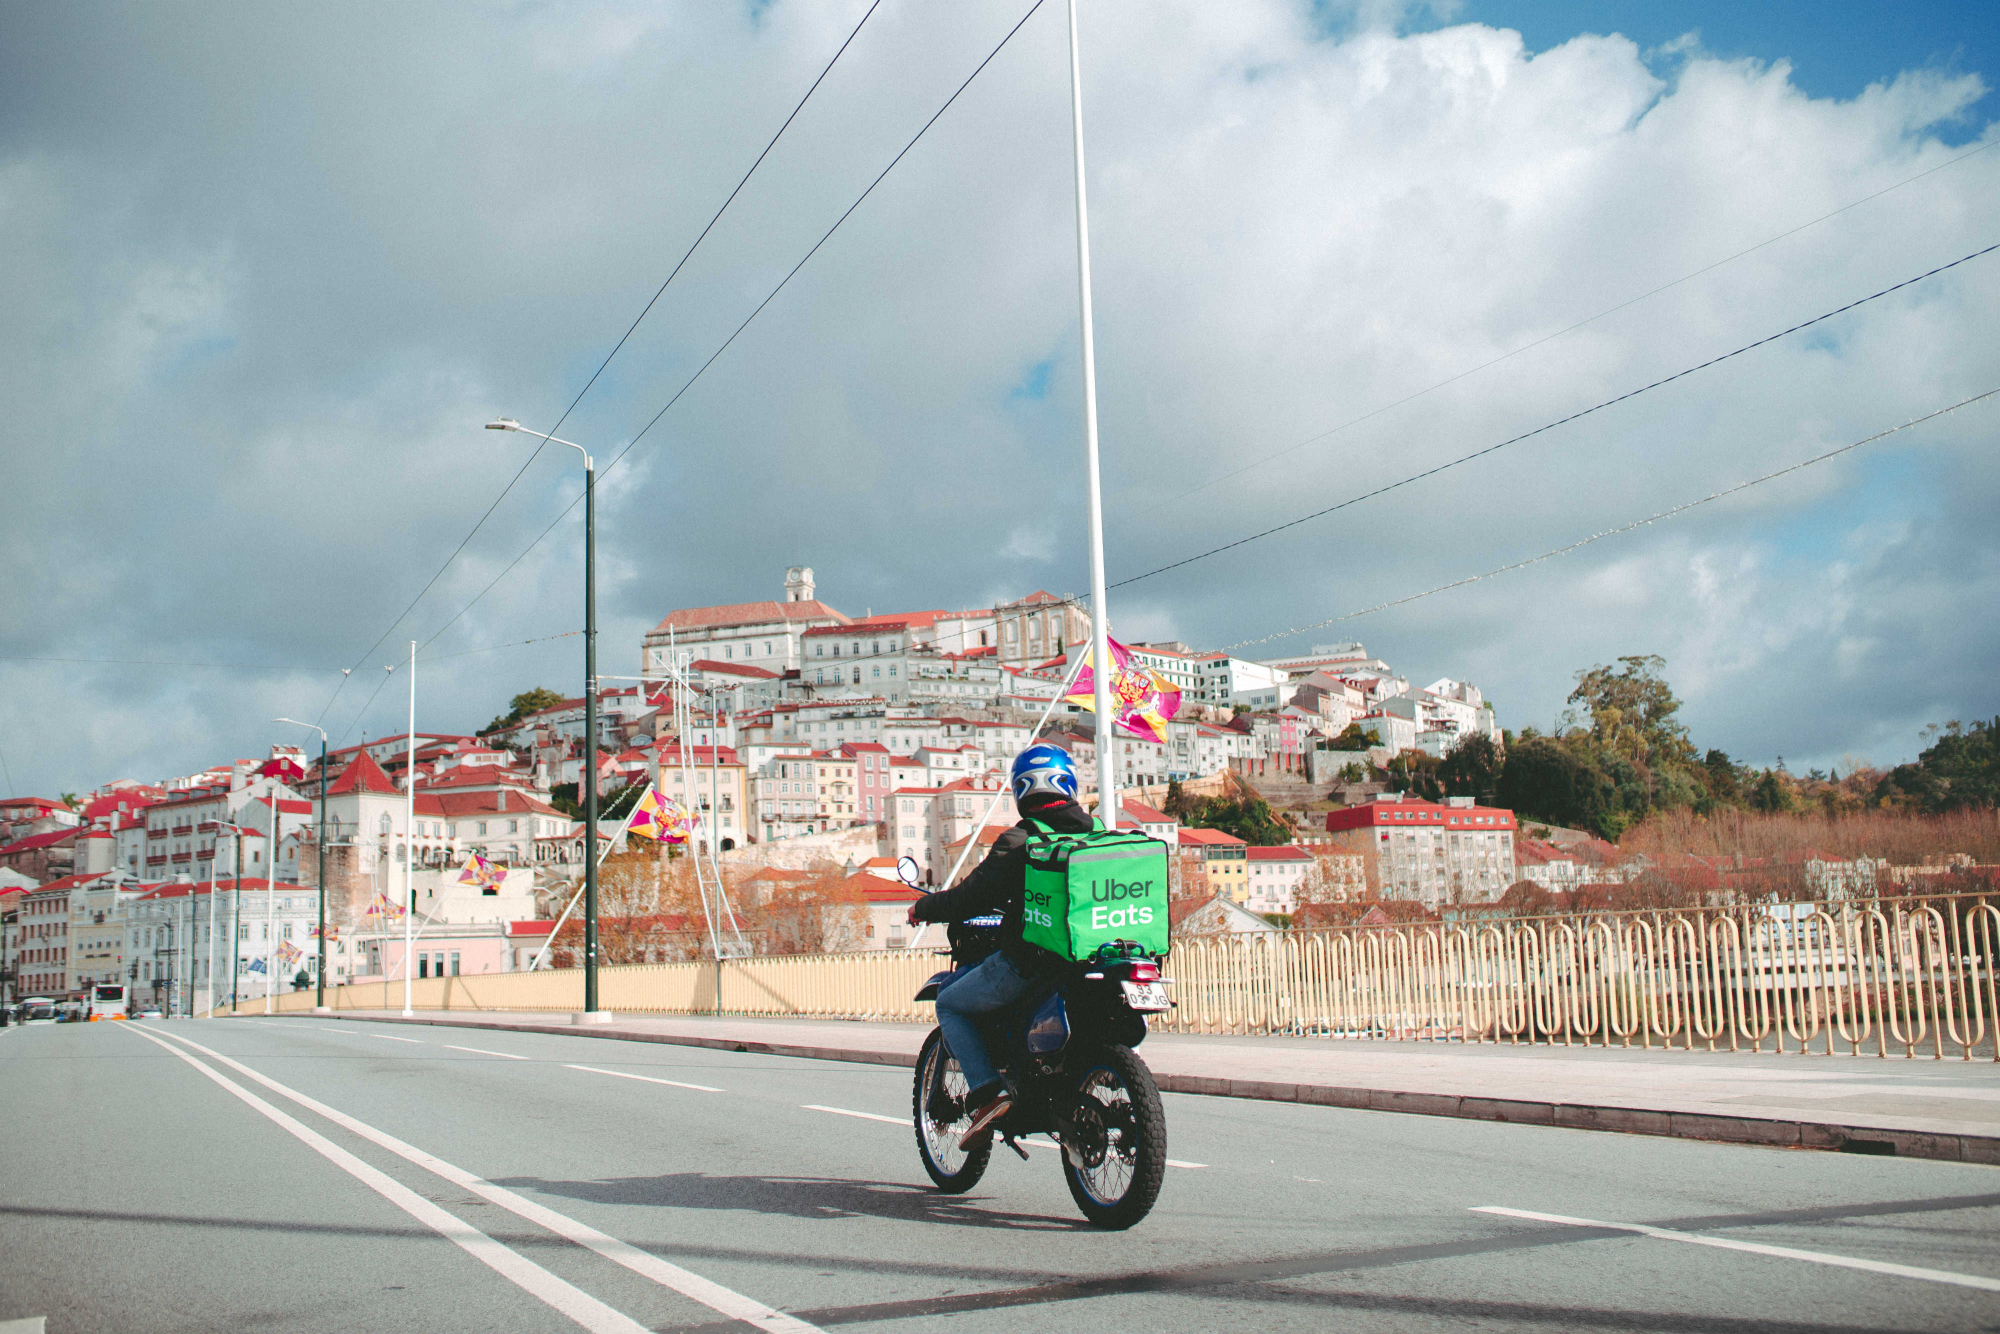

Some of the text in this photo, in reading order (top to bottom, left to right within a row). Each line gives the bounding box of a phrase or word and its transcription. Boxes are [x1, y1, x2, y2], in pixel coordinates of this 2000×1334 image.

[1092, 879, 1153, 902] Uber
[1024, 908, 1052, 927] ats
[1092, 904, 1153, 929] Eats
[1136, 984, 1152, 994] 93
